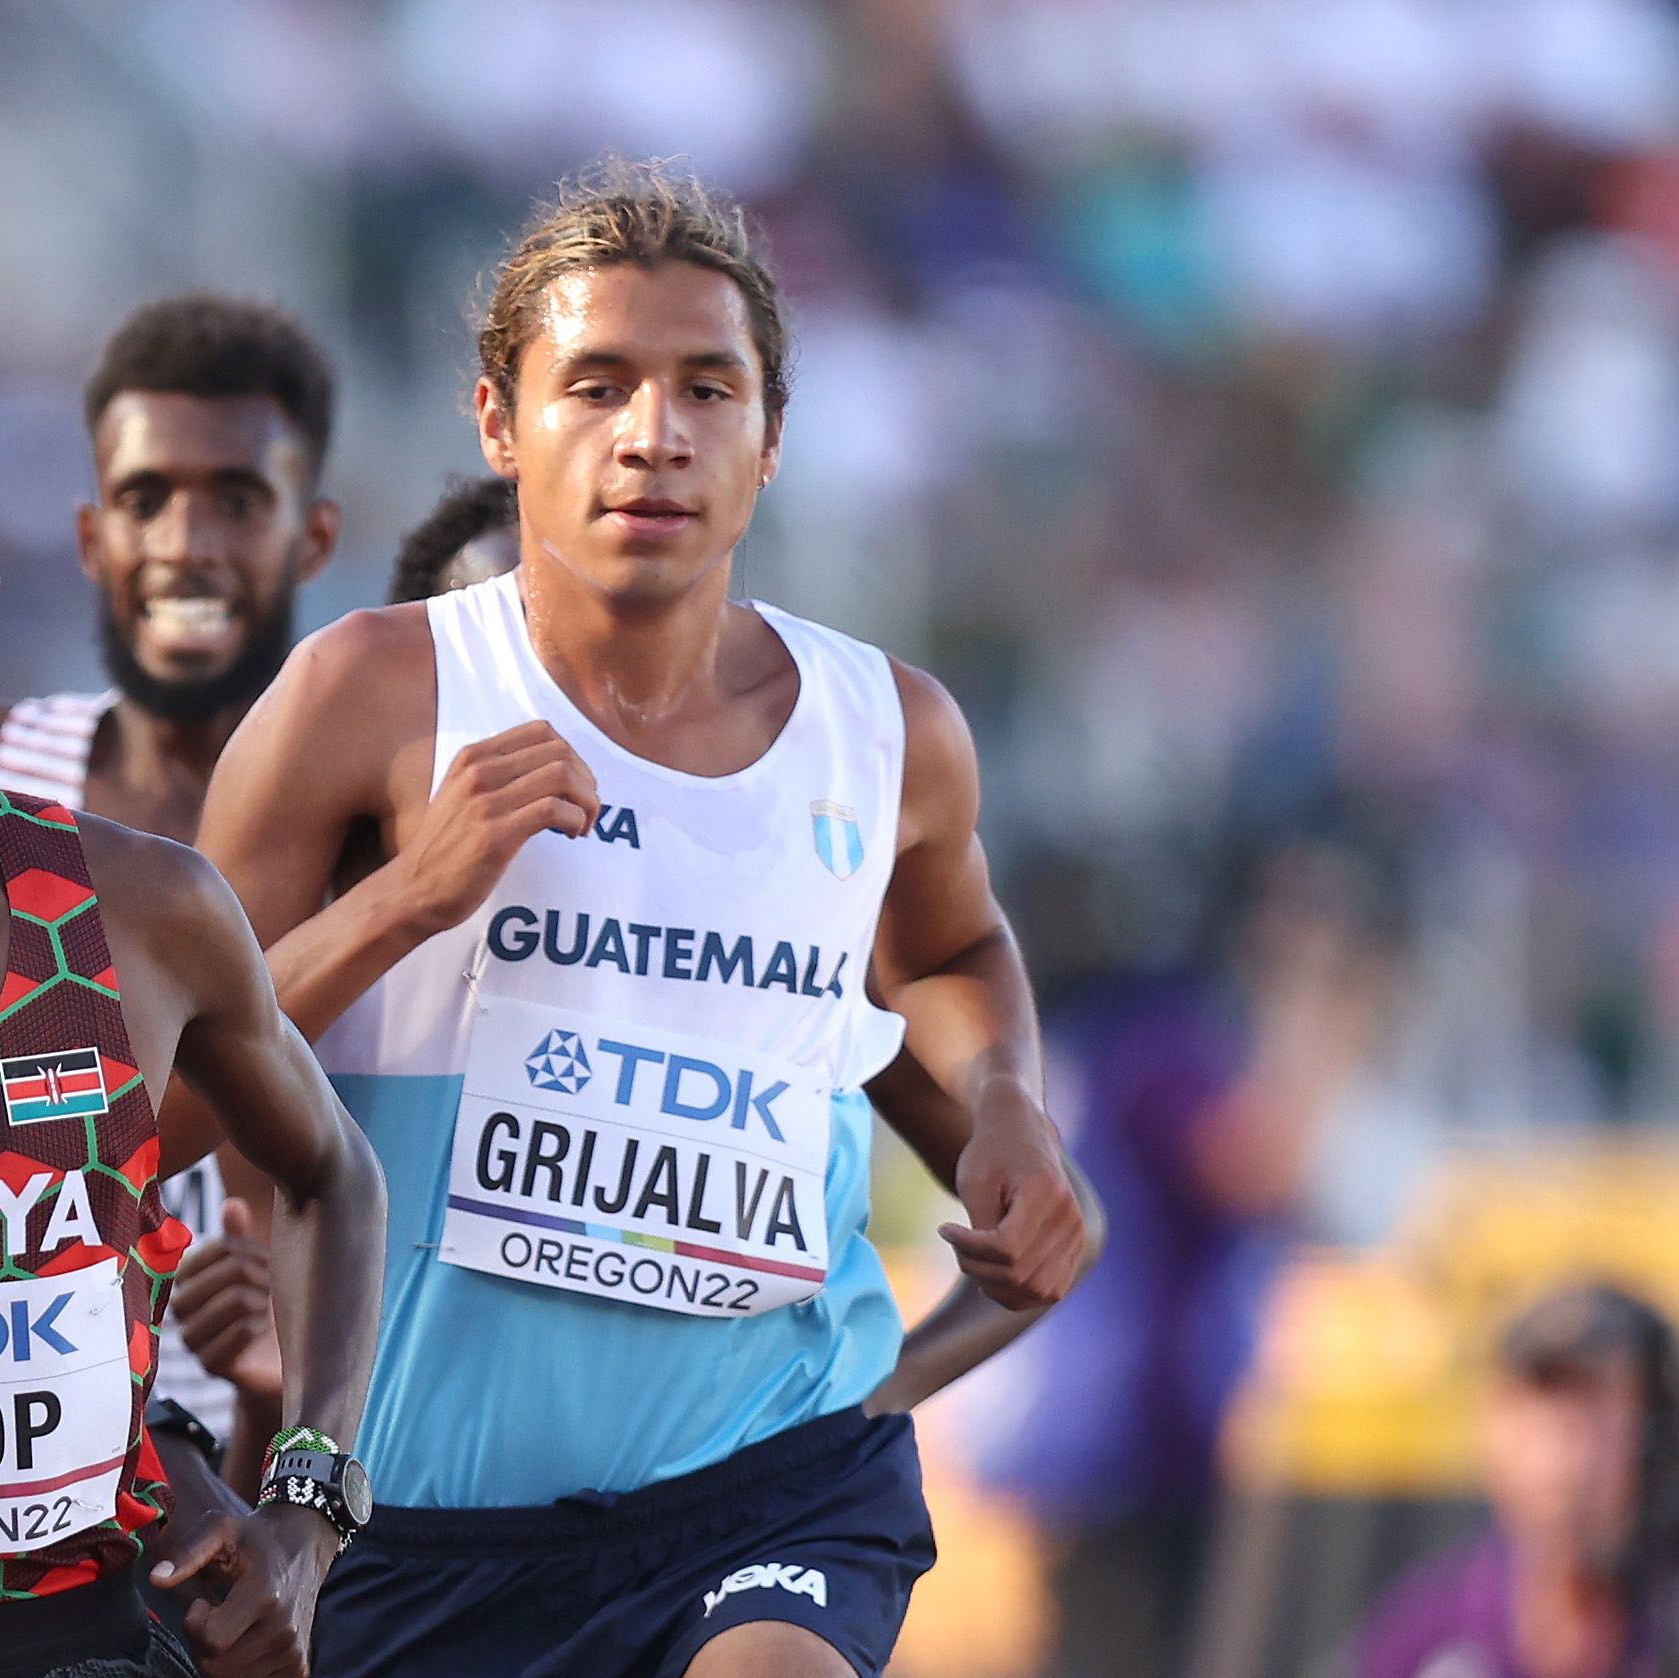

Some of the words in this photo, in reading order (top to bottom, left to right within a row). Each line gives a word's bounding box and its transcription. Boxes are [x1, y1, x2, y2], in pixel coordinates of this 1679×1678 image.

[596, 1038, 792, 1143] TDK
[475, 1111, 809, 1252] GRIJALVA
[499, 1231, 759, 1311] OREGON22
